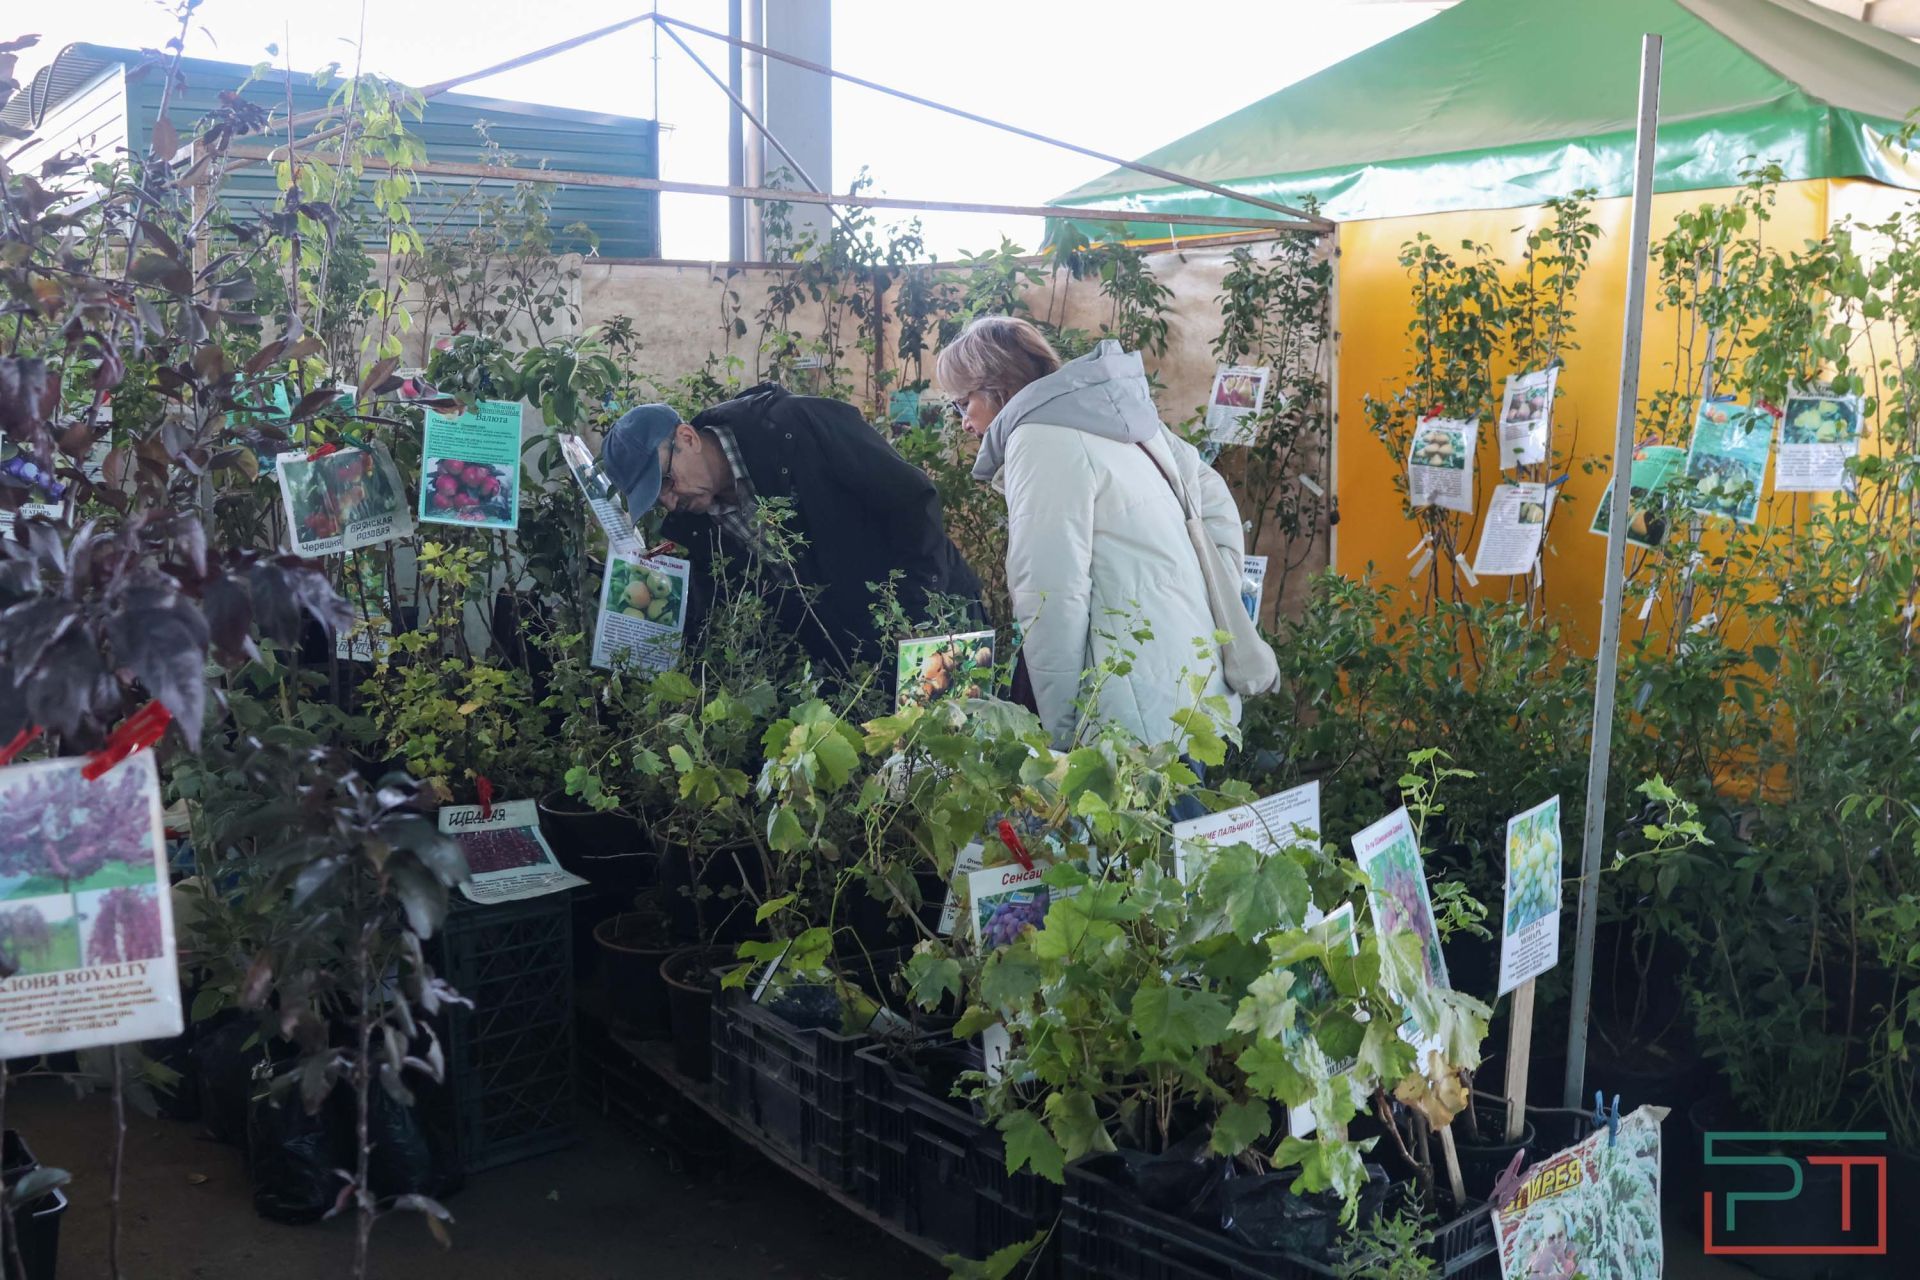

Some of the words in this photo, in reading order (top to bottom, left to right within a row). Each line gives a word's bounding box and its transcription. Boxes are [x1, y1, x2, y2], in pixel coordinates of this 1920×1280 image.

[475, 413, 508, 424] Валюта
[356, 525, 392, 542] РОЗОВАЯ
[301, 538, 344, 553] Черешня
[1217, 819, 1255, 838] ПАЛЬЧИКИ
[1002, 869, 1043, 886] Сенсац
[64, 962, 148, 985] ROYALTY
